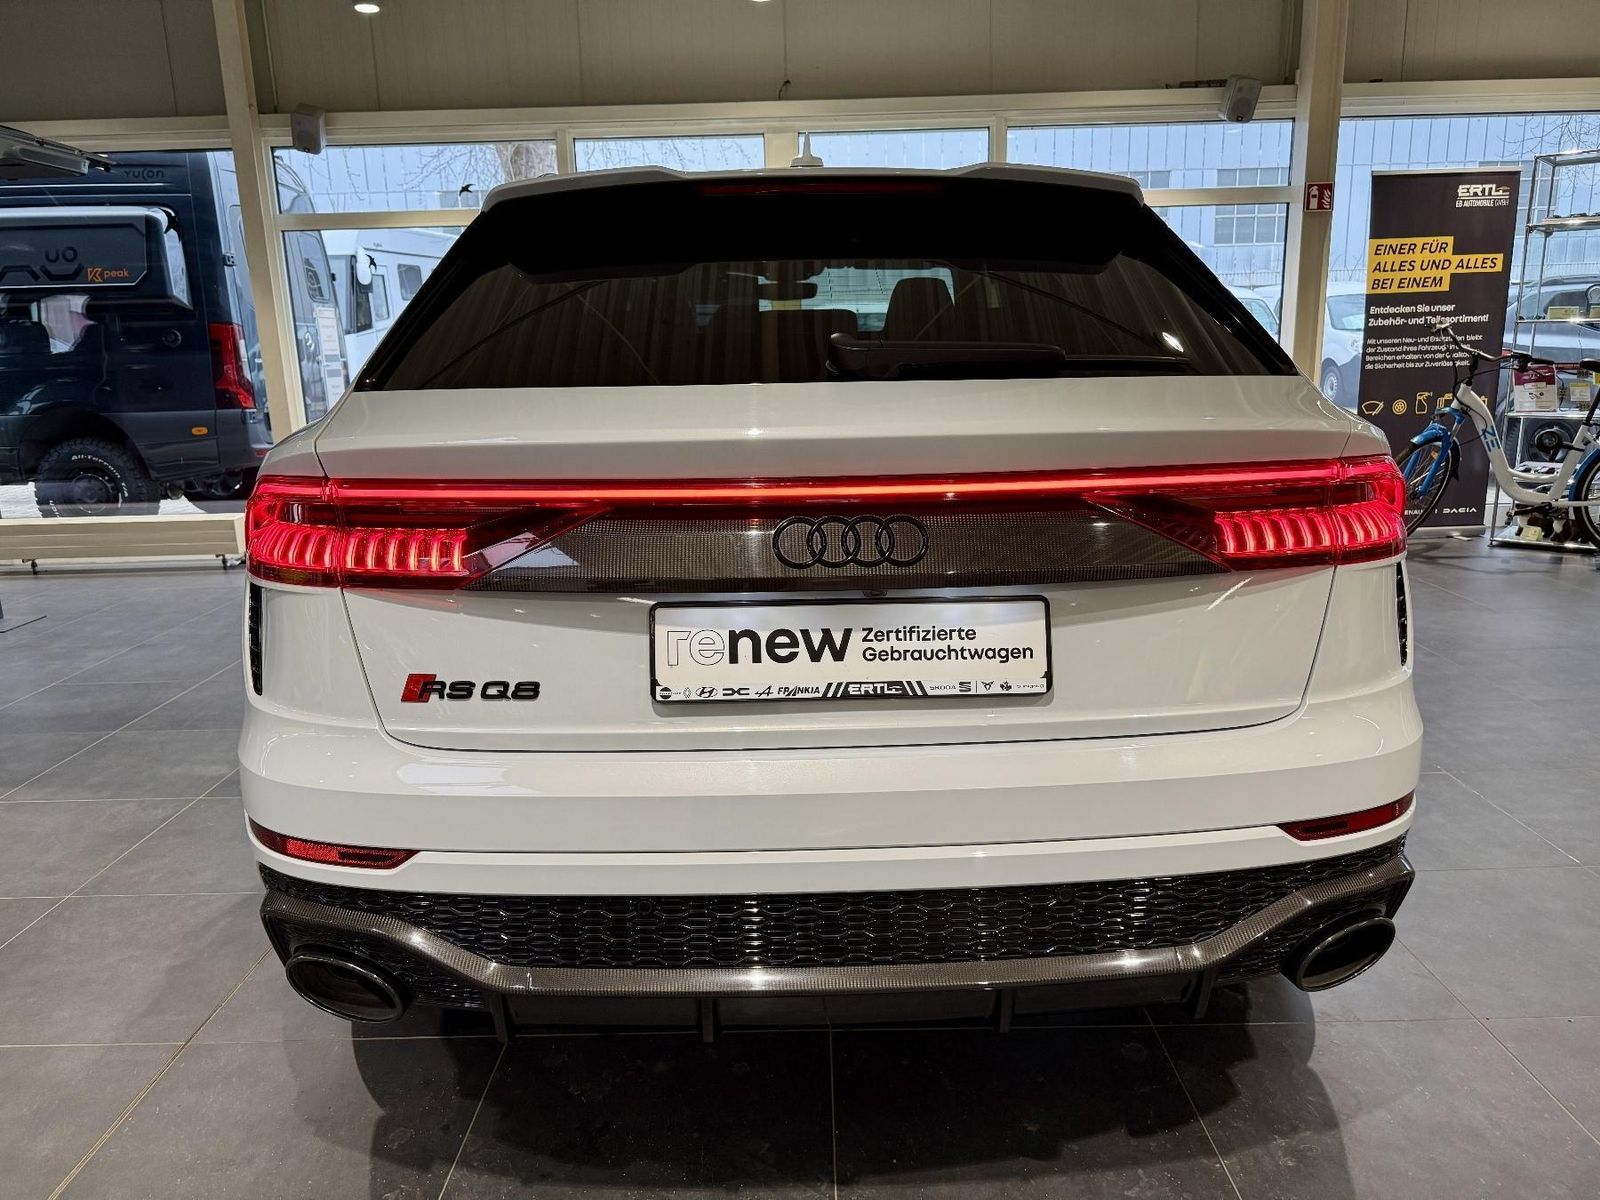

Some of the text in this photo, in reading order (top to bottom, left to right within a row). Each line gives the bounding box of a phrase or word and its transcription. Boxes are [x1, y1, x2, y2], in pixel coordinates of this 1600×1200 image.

[1457, 184, 1504, 197] ERTL
[1463, 199, 1494, 207] AUTOMOBILE
[1374, 239, 1449, 256] EINER FÜR
[1372, 257, 1498, 273] ALLES UND ALLES
[104, 268, 129, 279] peak
[1371, 276, 1443, 290] BEI EINEM
[1369, 303, 1456, 315] Entdecken Sie unser
[1368, 316, 1407, 327] Zubehör-
[1408, 316, 1425, 325] und
[1377, 337, 1402, 345] unseren
[1403, 336, 1417, 344] Neu-
[1466, 333, 1483, 342] bleibt
[1366, 346, 1376, 354] der
[1376, 345, 1402, 353] Zustand
[1365, 354, 1395, 362] Bereichen
[1374, 361, 1405, 369] Sicherheit
[666, 625, 977, 667] renew Zertifizierte
[862, 645, 1034, 663] Gebrauchtwagen
[416, 680, 541, 701] RS Q8
[777, 686, 821, 697] FRANKIA
[848, 683, 894, 696] ERTL
